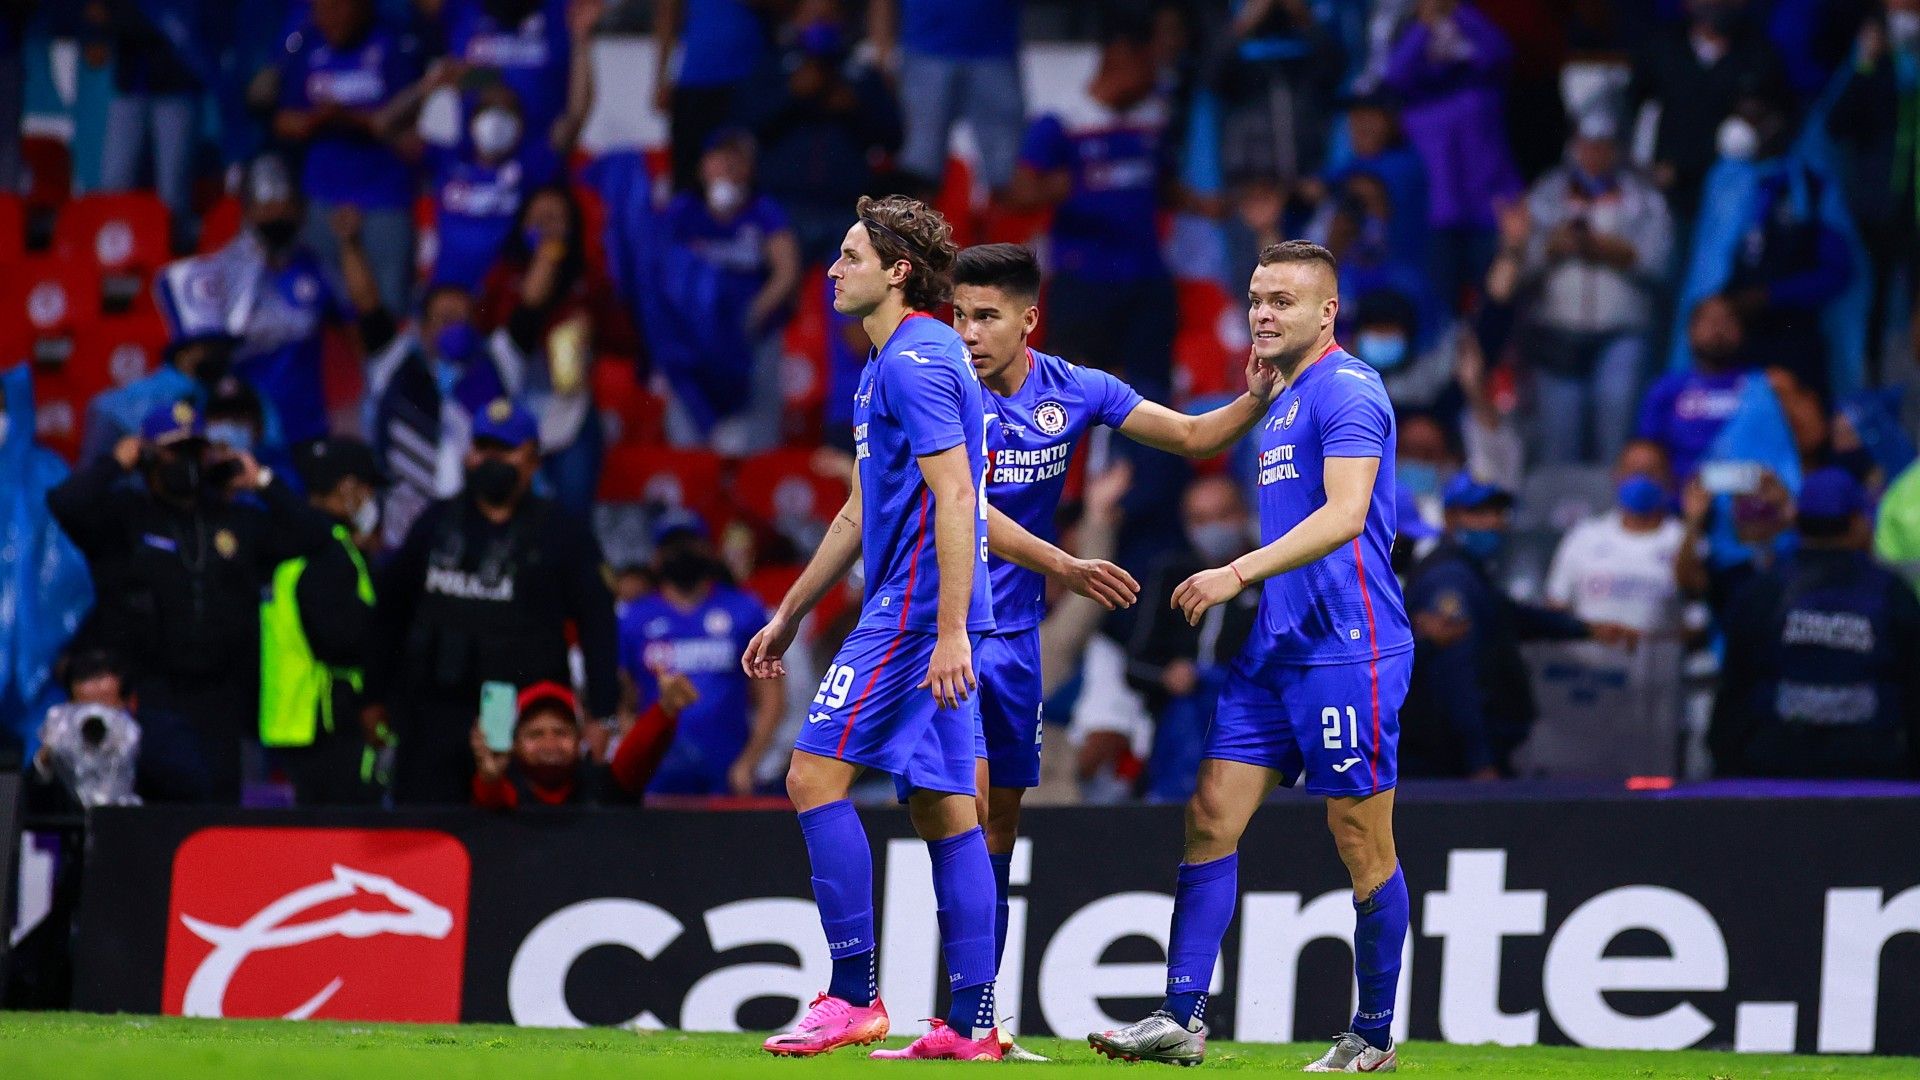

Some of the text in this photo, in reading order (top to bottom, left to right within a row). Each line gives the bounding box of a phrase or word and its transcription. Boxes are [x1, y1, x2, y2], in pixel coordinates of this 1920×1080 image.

[993, 459, 1067, 483] CRUZ AZUL
[995, 443, 1068, 466] CEMENTO
[812, 663, 855, 709] 29
[1321, 705, 1358, 749] 21
